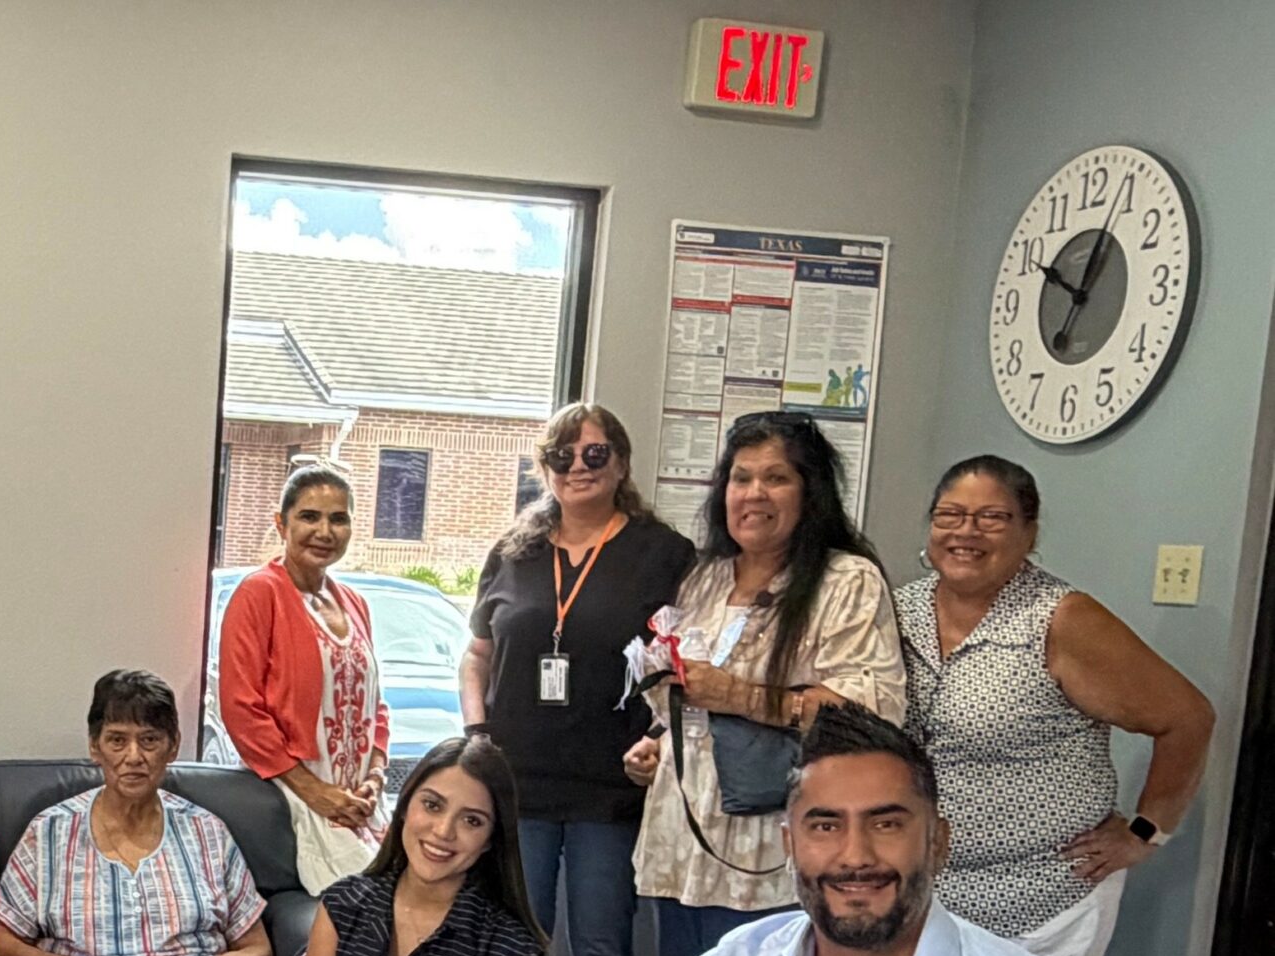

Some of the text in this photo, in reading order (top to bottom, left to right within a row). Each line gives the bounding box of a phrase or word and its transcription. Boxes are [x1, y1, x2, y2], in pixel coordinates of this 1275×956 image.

[716, 26, 809, 109] EXIT
[1077, 167, 1109, 211] 12
[1121, 173, 1136, 214] 1
[1045, 193, 1069, 234] 11
[1140, 208, 1161, 250] 2
[759, 237, 803, 251] TEXAS
[1017, 237, 1044, 276] 10
[1149, 264, 1170, 306] 3
[1003, 288, 1020, 326] 9
[1006, 339, 1023, 376] 8
[1128, 323, 1146, 363] 4
[1028, 372, 1045, 411] 7
[1060, 384, 1078, 423] 6
[1096, 366, 1115, 407] 5
